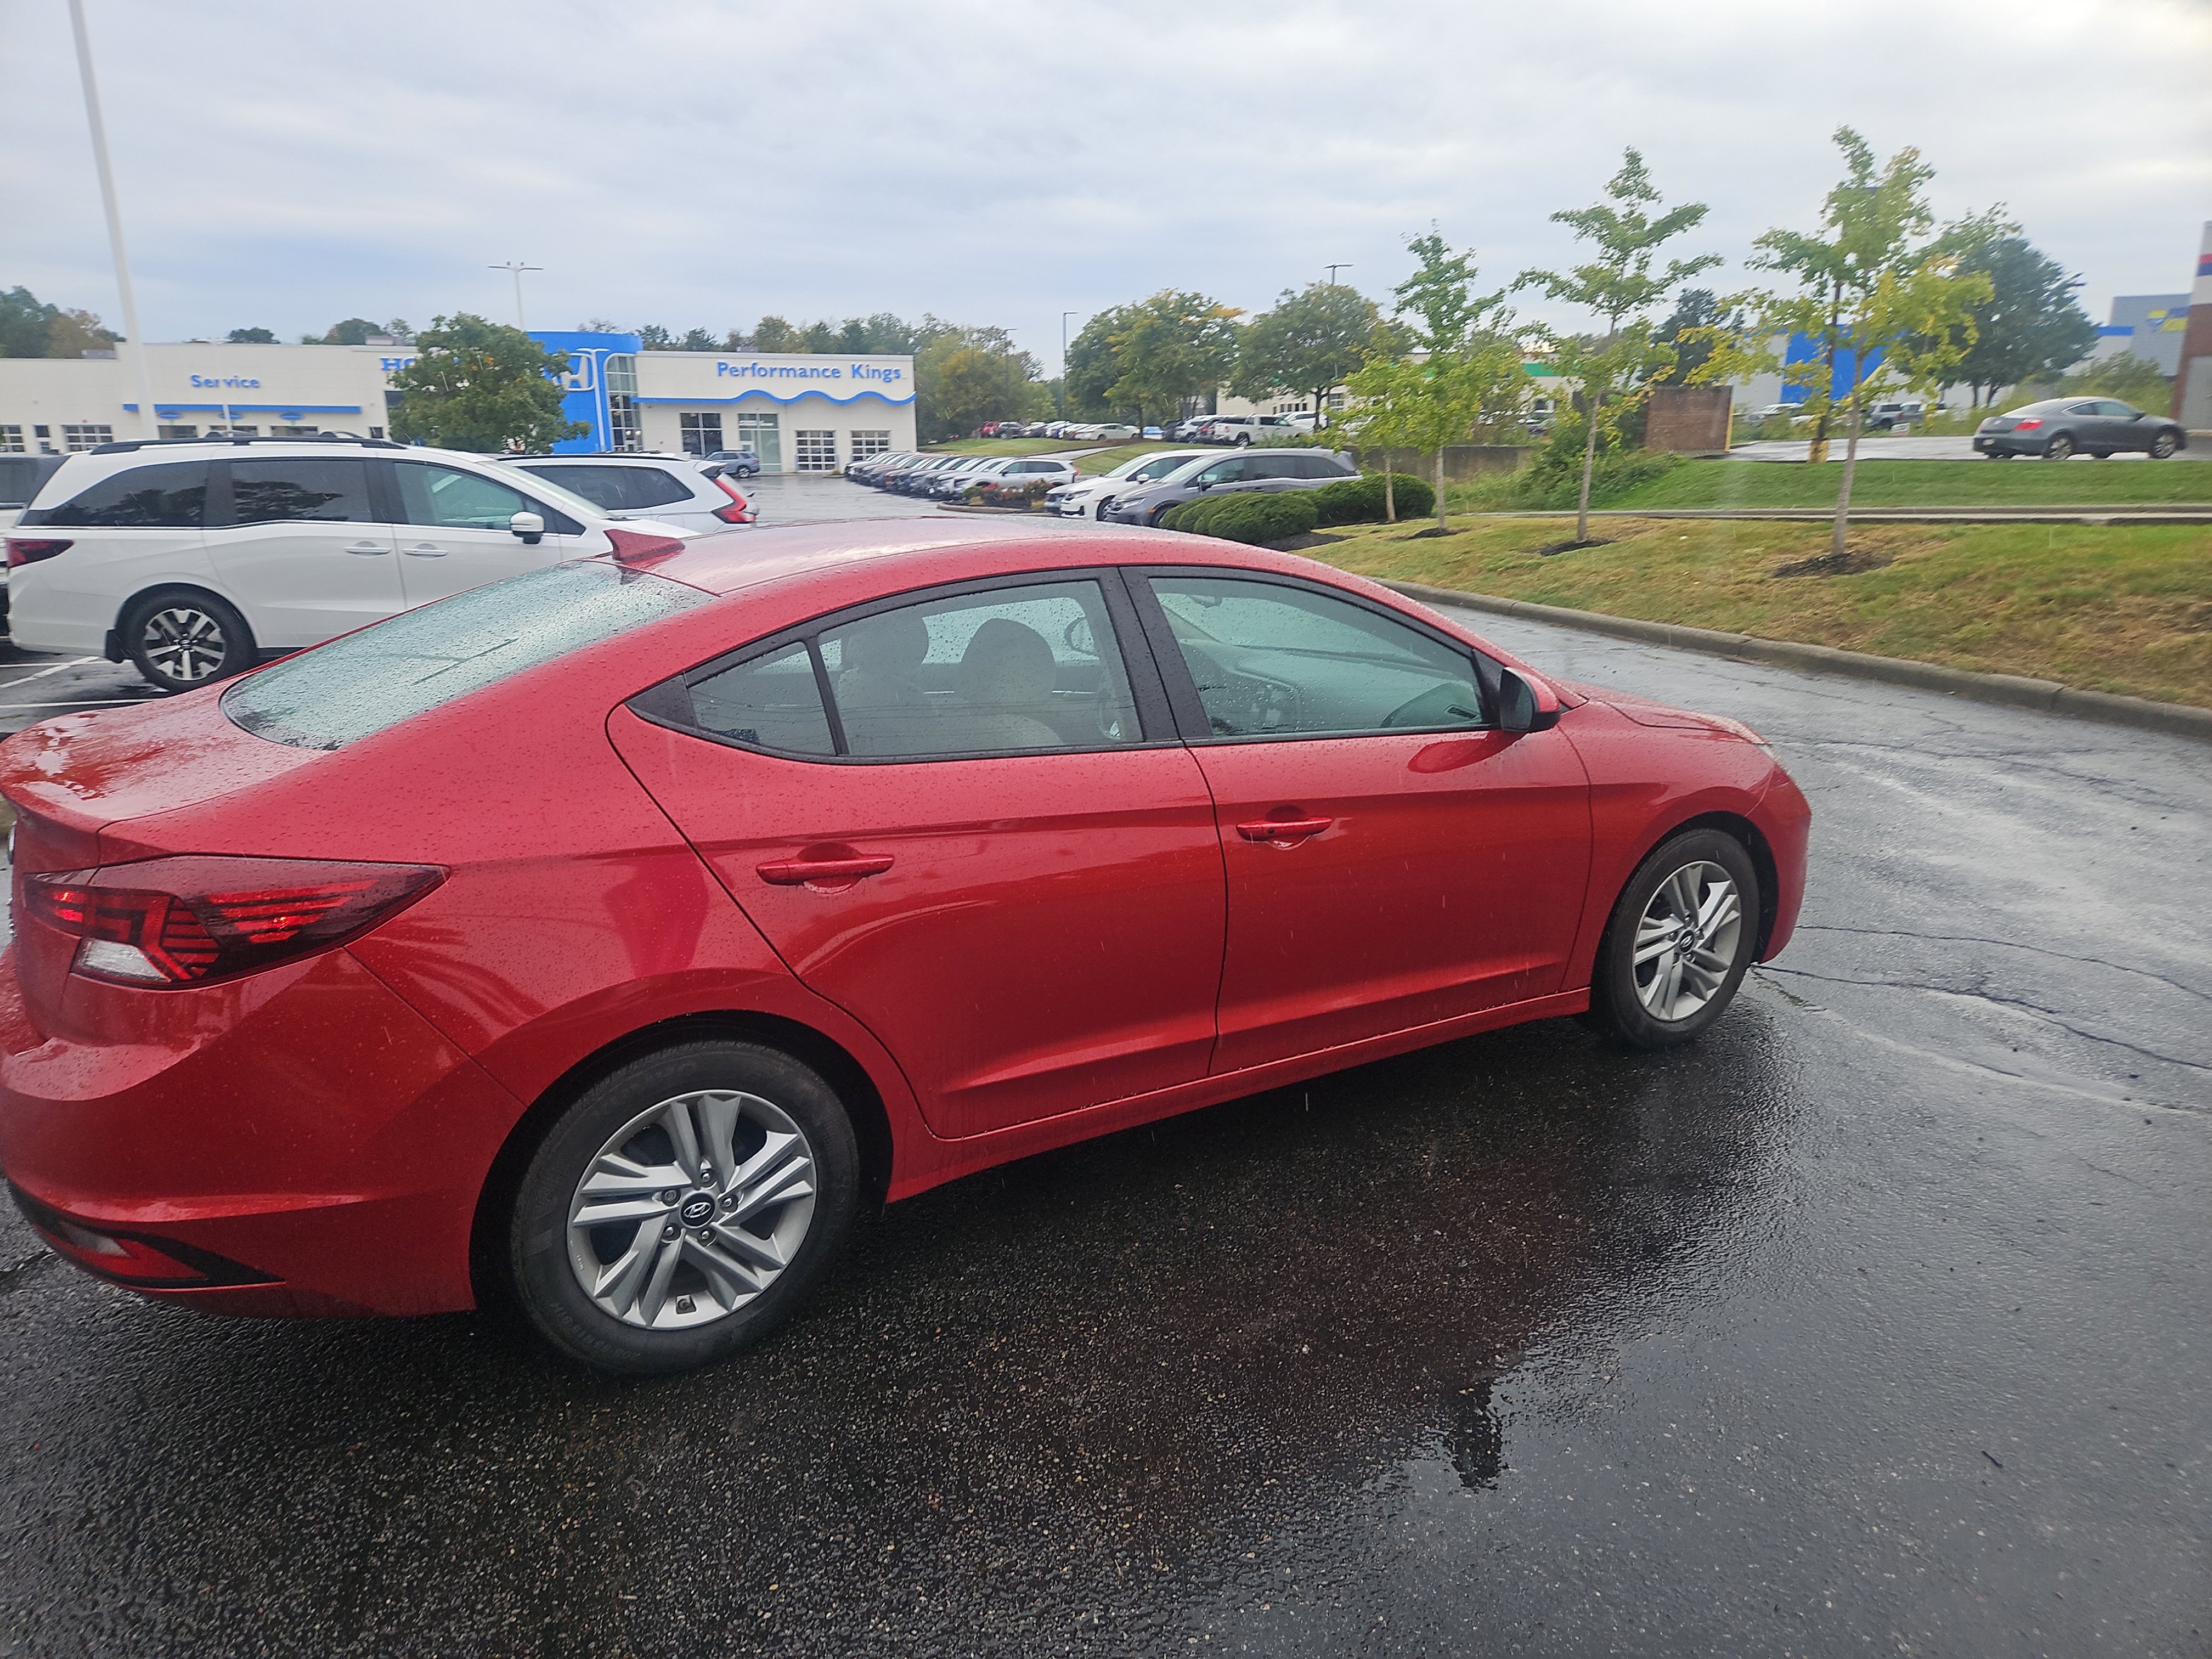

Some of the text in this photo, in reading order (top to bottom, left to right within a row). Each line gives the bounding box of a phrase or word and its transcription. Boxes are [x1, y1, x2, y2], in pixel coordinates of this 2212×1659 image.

[190, 374, 261, 388] Service
[716, 362, 902, 383] Performance Kings
